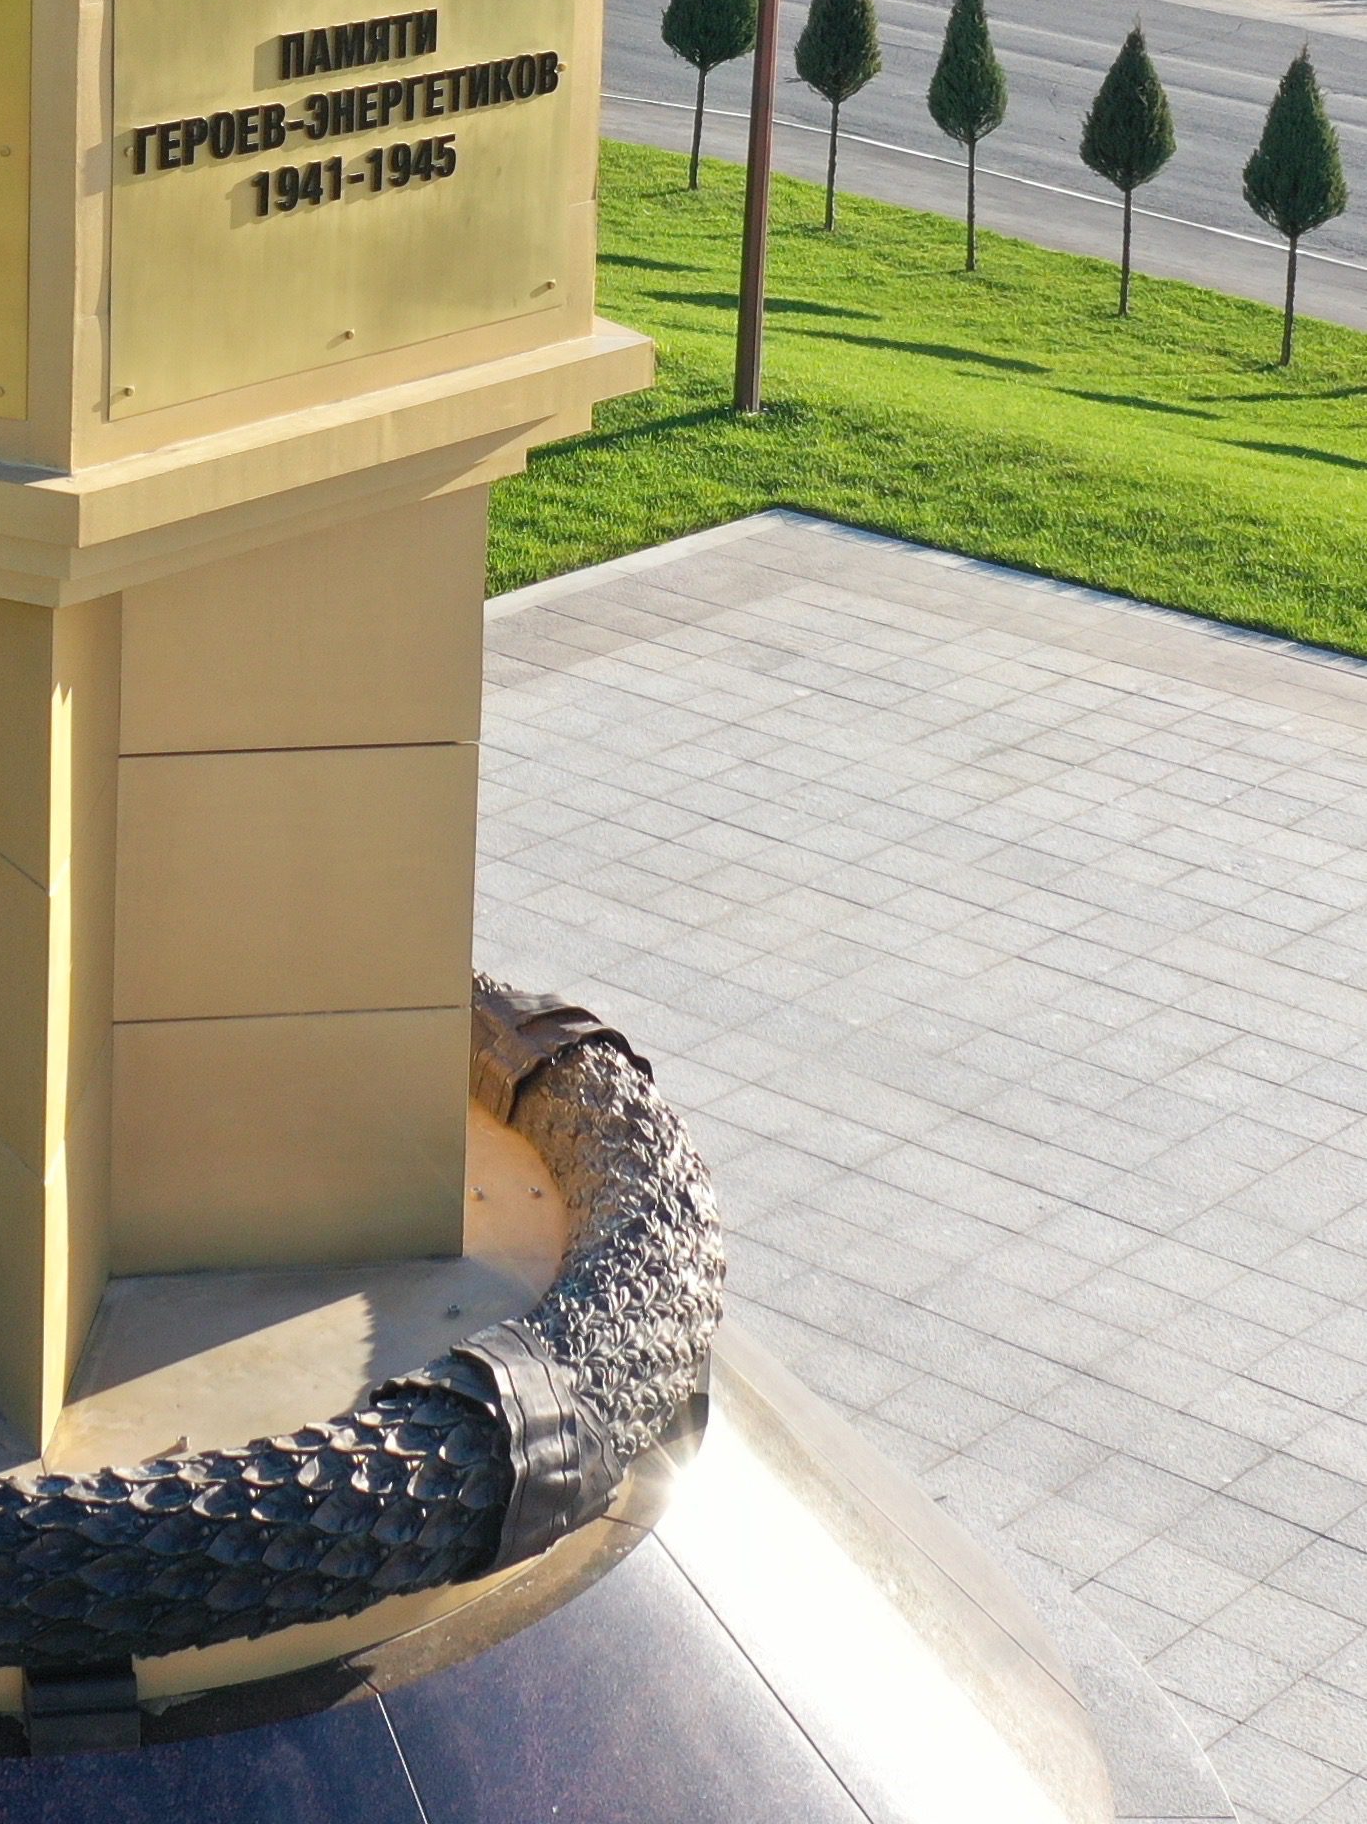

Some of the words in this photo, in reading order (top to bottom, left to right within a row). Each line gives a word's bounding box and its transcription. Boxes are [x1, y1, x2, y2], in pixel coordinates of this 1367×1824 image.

[279, 8, 438, 80] ПАМЯТИ
[133, 51, 559, 174] ГЕРОЕВ-ЭНЕРГЕТИКОВ
[251, 133, 457, 216] 1941-1945
